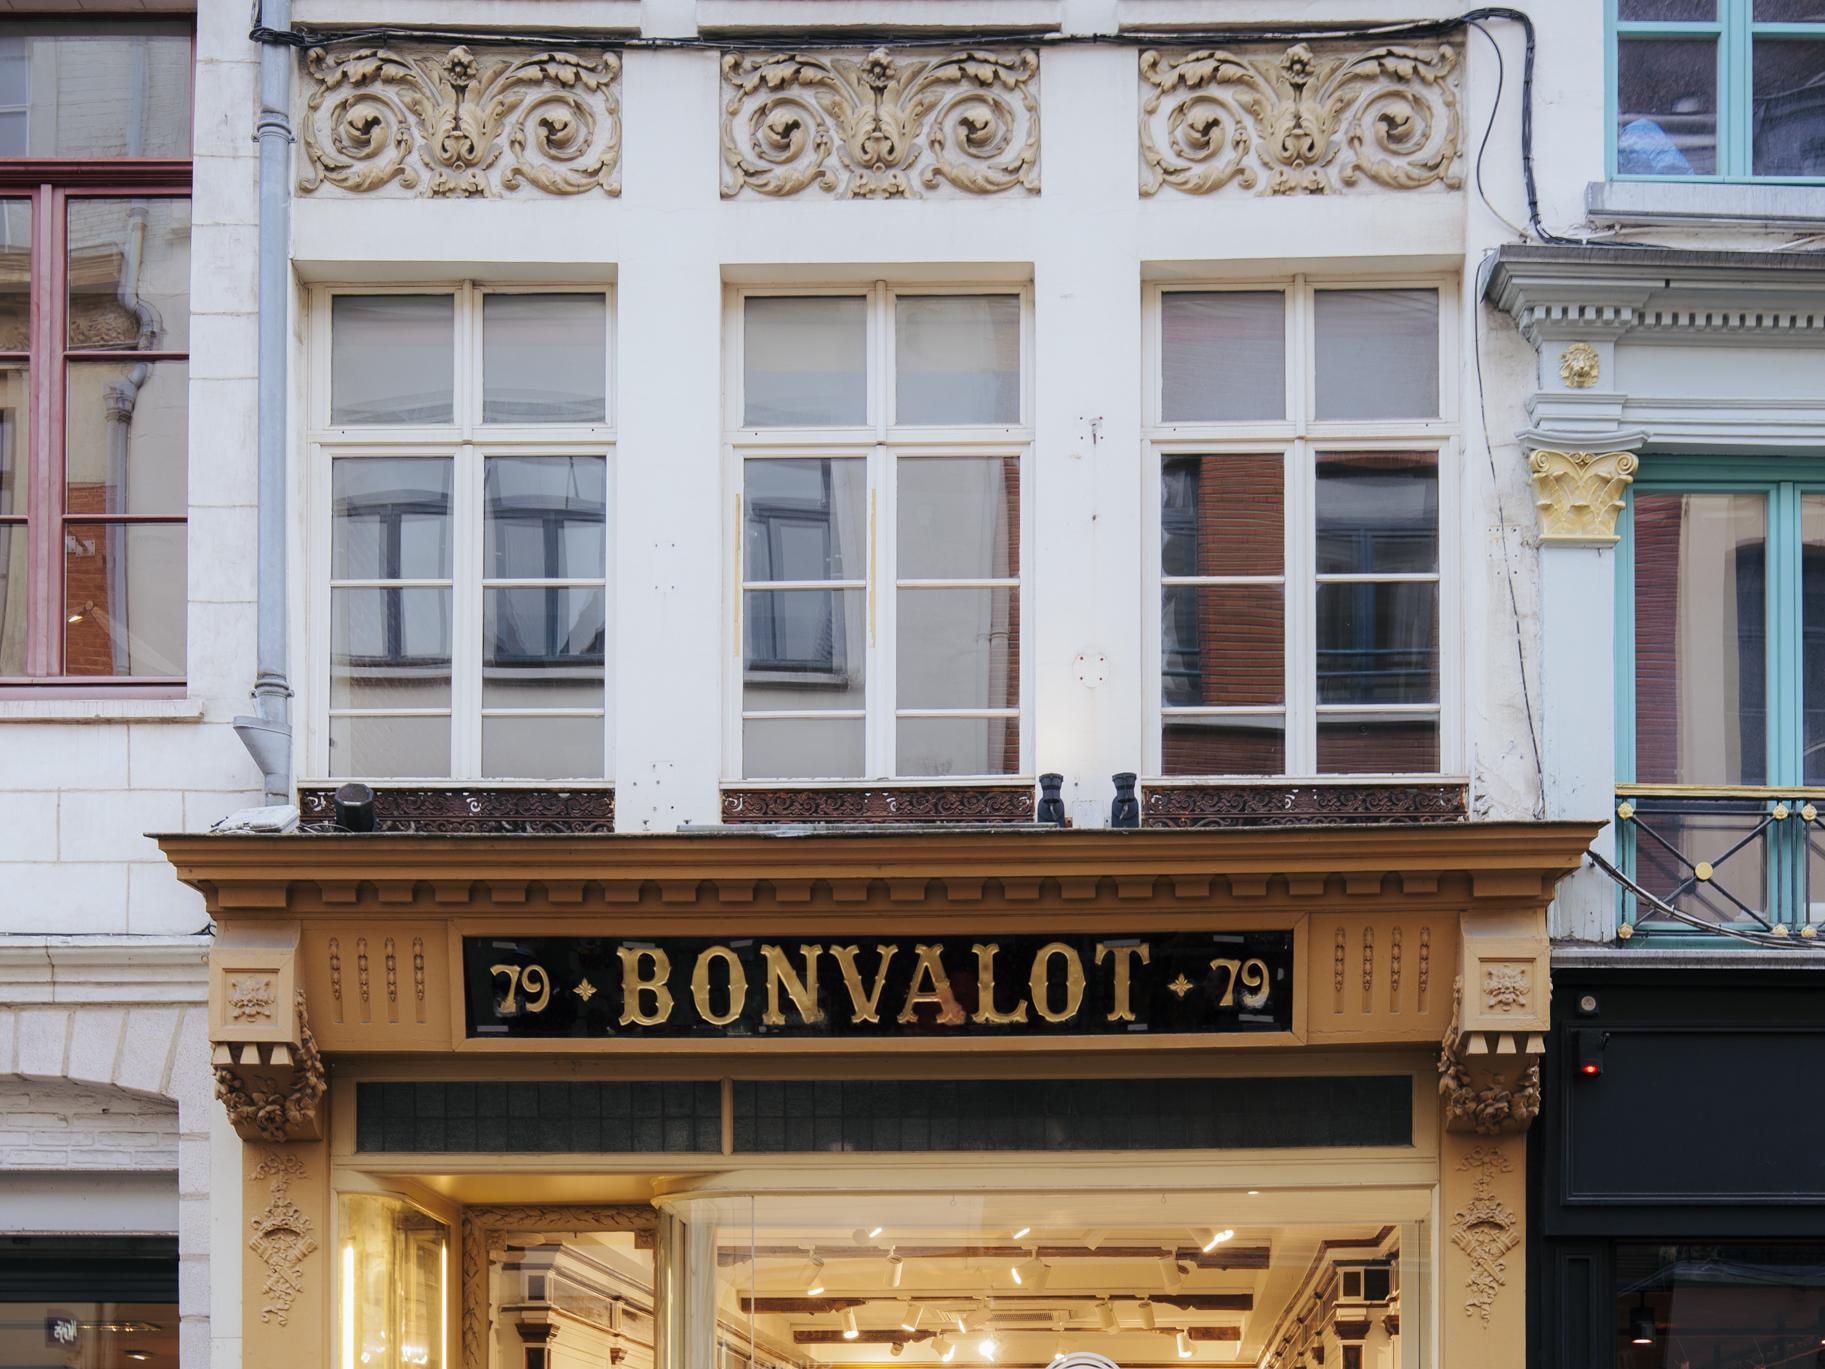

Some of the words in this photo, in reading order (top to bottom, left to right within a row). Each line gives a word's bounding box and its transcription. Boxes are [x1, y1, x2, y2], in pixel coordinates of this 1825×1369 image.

[489, 963, 551, 1013] 79
[616, 943, 1151, 1027] BONVALOT
[1209, 957, 1271, 1009] 79
